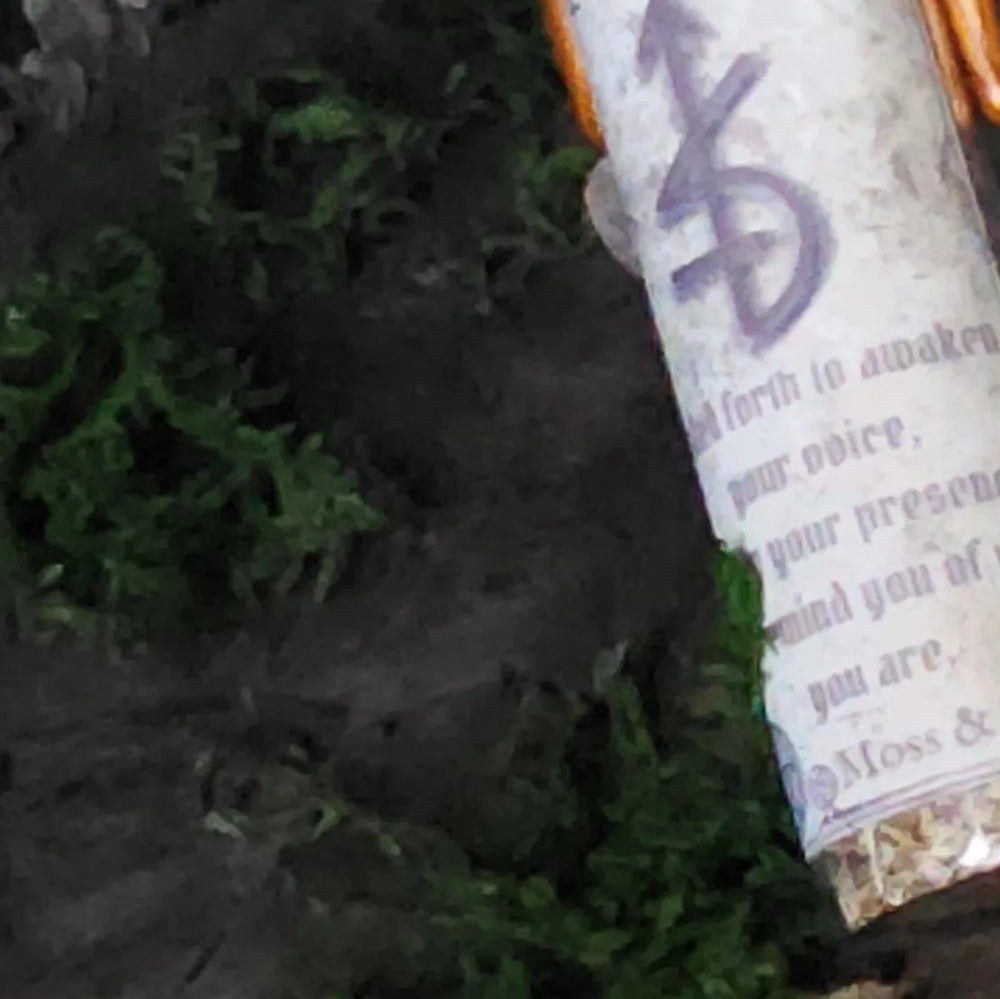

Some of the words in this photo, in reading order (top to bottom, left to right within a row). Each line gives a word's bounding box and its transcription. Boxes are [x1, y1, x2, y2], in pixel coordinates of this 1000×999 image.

[722, 370, 802, 430] forth
[811, 358, 846, 394] to
[860, 321, 1000, 380] awaken
[766, 512, 841, 580] your
[765, 580, 854, 646] mind
[858, 563, 937, 621] you
[942, 538, 982, 587] of
[808, 663, 869, 724] you
[953, 705, 997, 749] &
